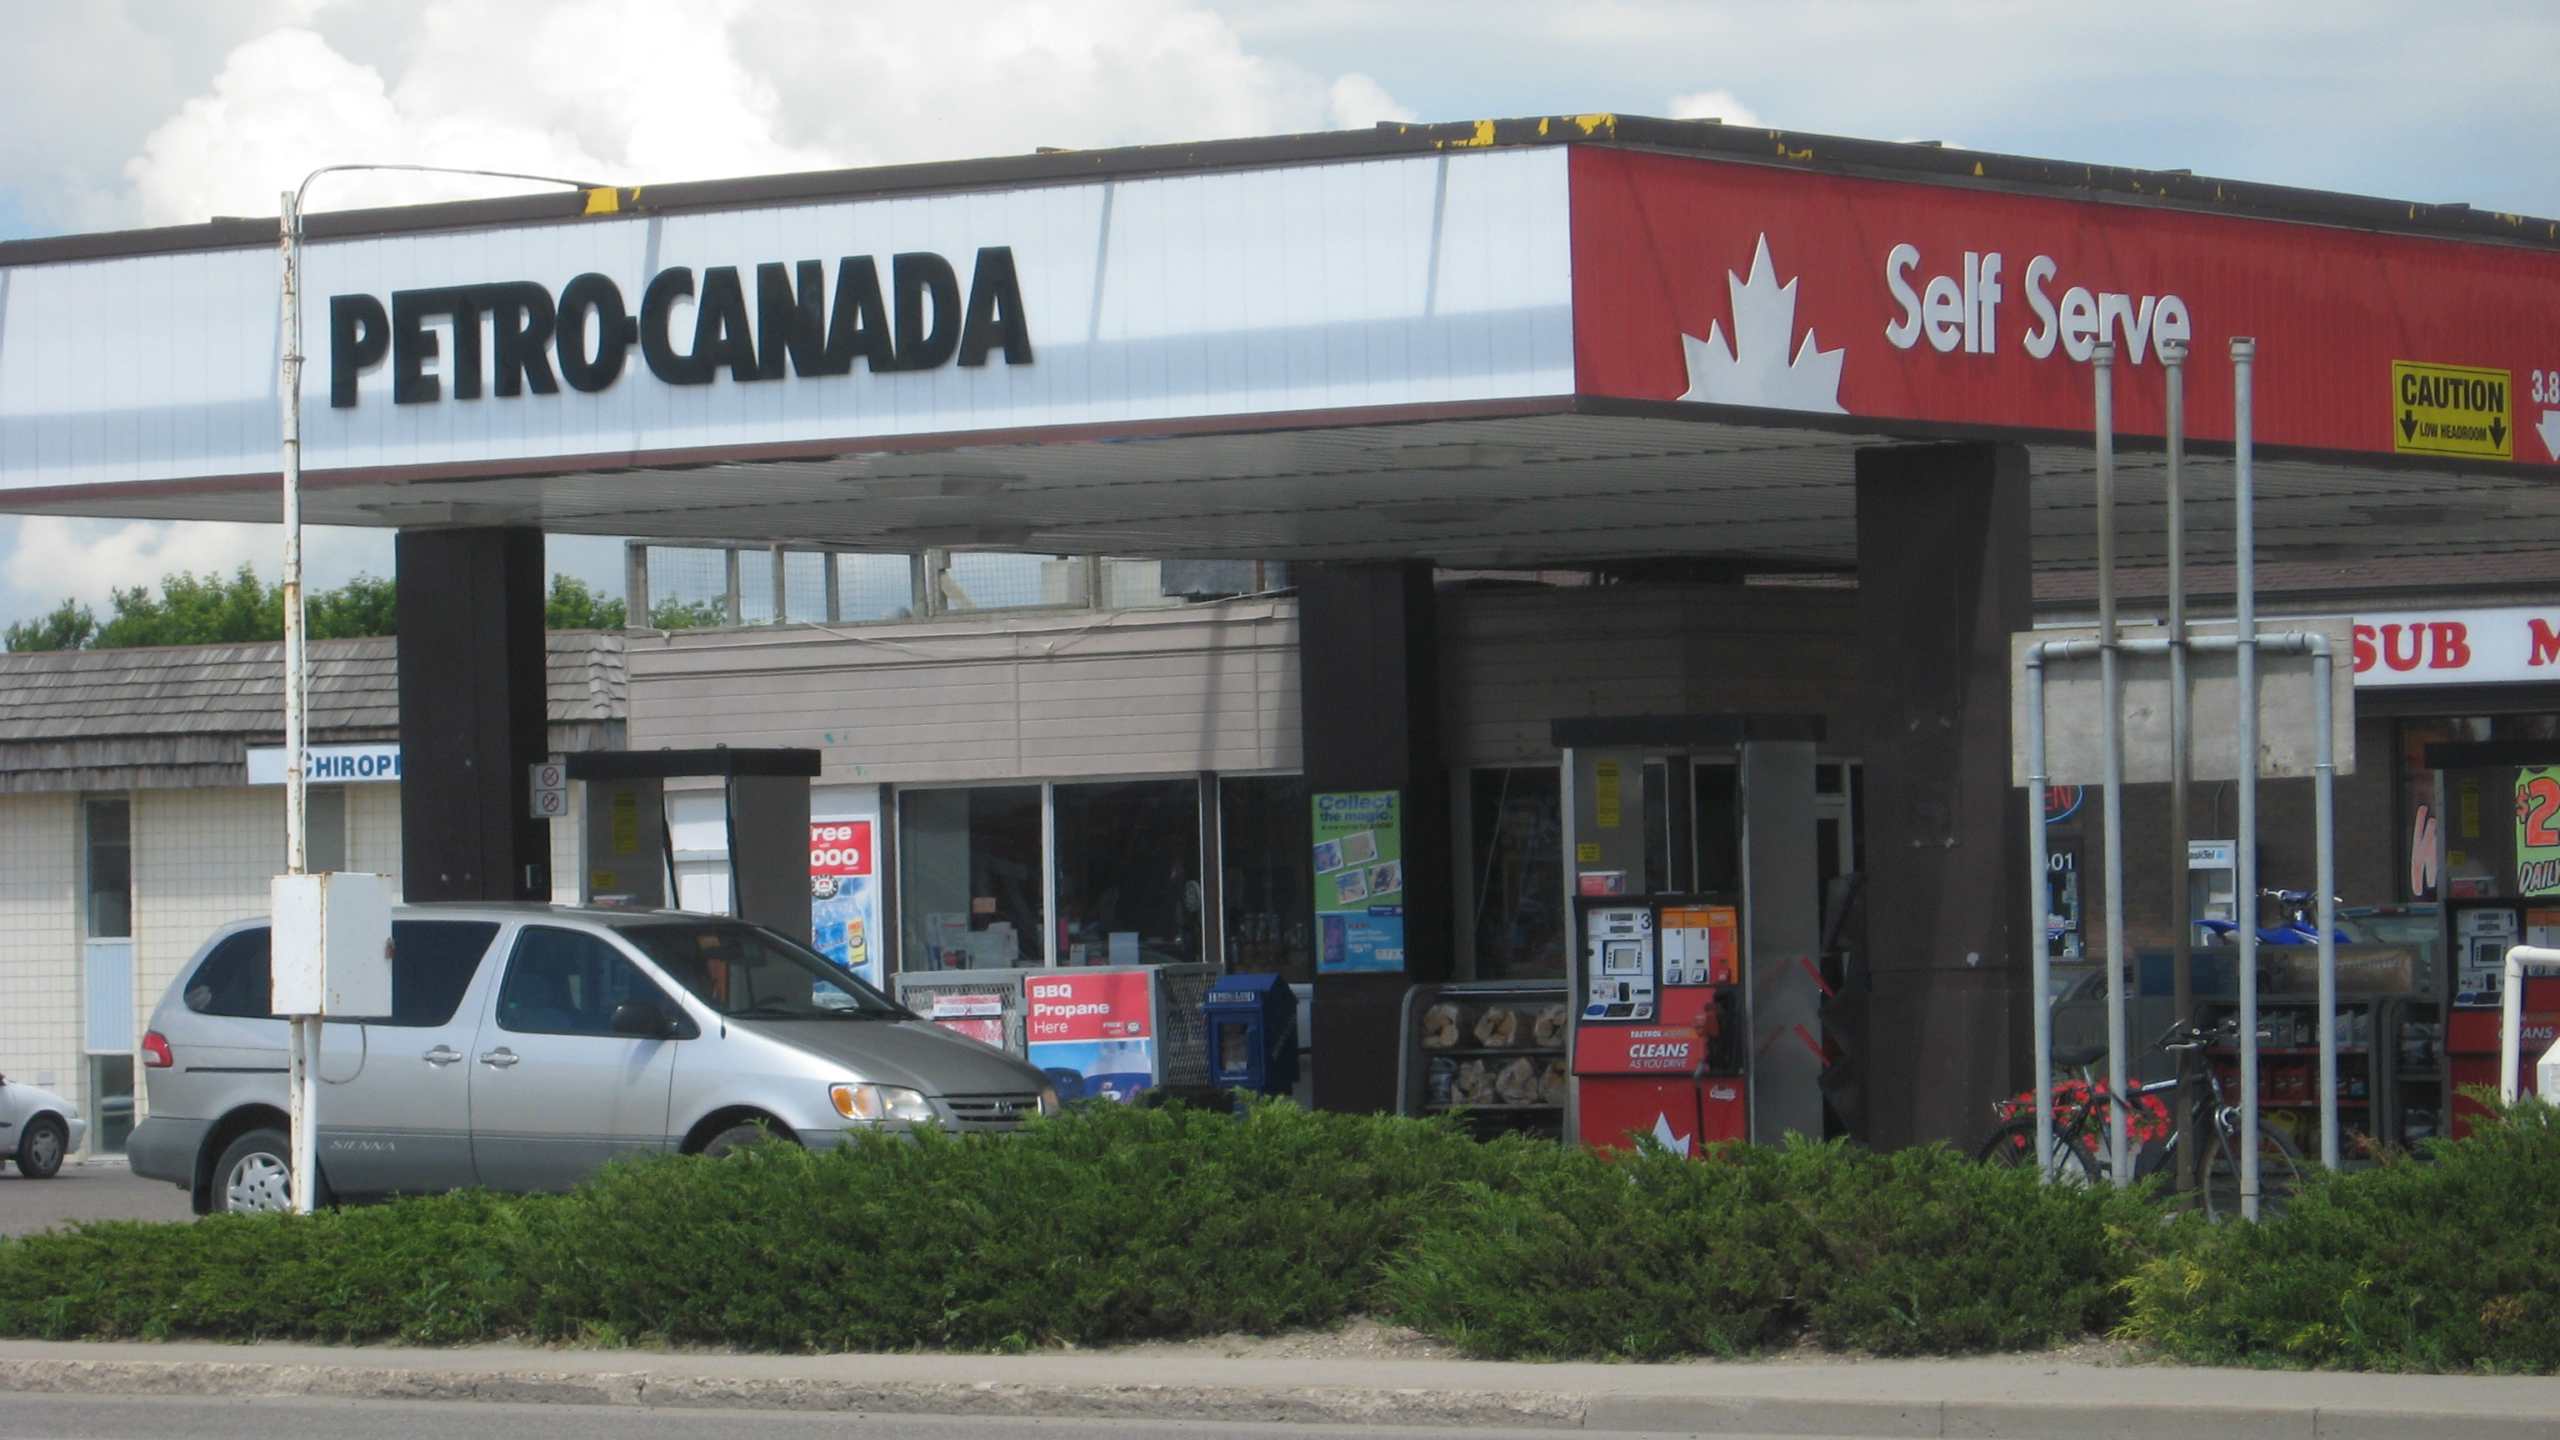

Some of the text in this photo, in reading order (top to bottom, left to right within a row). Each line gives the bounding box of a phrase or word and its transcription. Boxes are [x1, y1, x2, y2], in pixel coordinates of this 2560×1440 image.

[1885, 243, 2190, 367] Self Serve
[330, 246, 1033, 408] PETRO-CANADA
[2402, 374, 2504, 413] CAUTION
[2420, 422, 2487, 442] LOW HEADROOM
[2354, 622, 2471, 673] SUB
[1319, 795, 1394, 810] Collect
[1321, 812, 1341, 821] the
[811, 826, 852, 842] ree
[1641, 913, 1652, 930] 3
[2507, 912, 2515, 927] 1
[1033, 984, 1073, 999] BBQ
[1034, 1003, 1110, 1019] Propane
[1034, 1021, 1068, 1034] Here
[1630, 1030, 1662, 1038] TACTROL
[1629, 1043, 1689, 1058] CLEANS
[1629, 1058, 1687, 1068] AS YOU DRIVE
[330, 1140, 396, 1151] SIENNA
